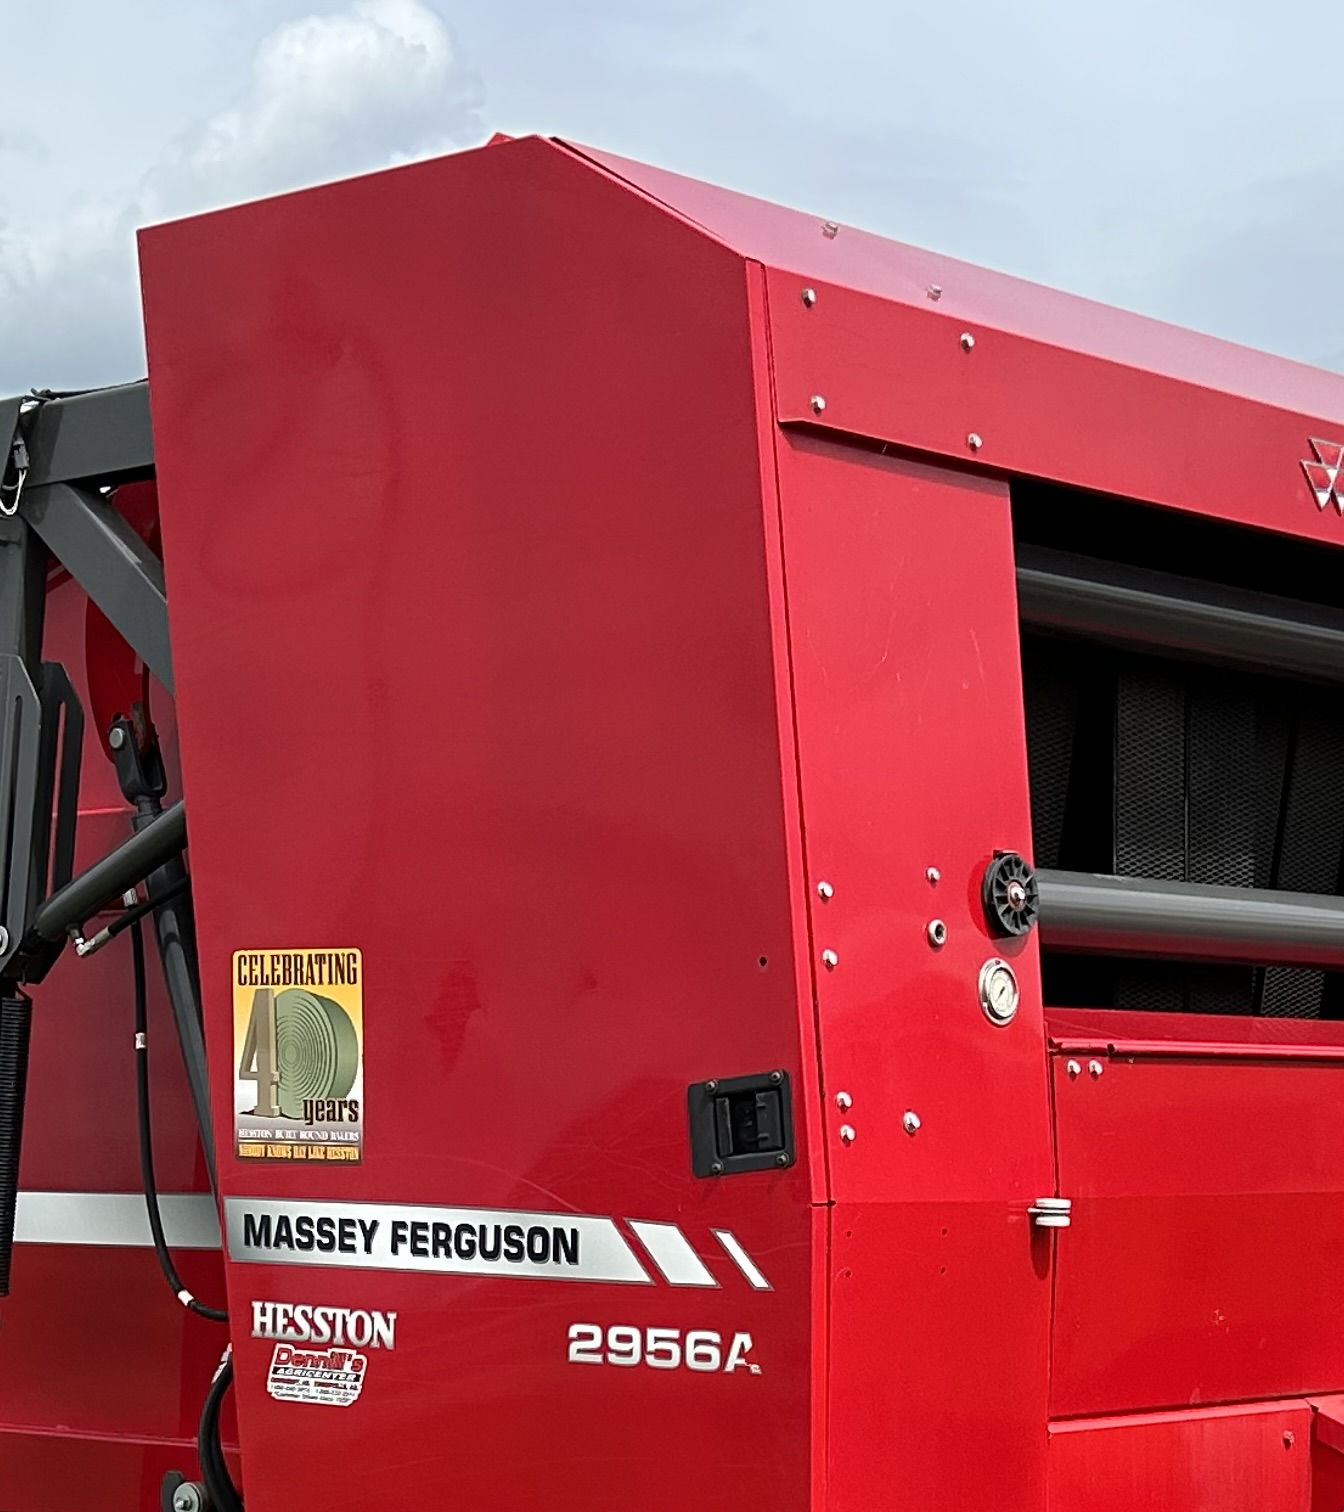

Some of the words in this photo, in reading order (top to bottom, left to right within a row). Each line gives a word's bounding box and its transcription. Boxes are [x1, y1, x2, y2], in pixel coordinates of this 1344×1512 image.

[238, 953, 357, 985] CELEBRATING
[303, 1099, 359, 1125] years
[243, 1213, 380, 1254] MASSEY
[391, 1221, 579, 1265] FERGUSON
[251, 1301, 397, 1349] HESSTON
[274, 1347, 364, 1372] Dennill's
[567, 1323, 763, 1374] 2956A
